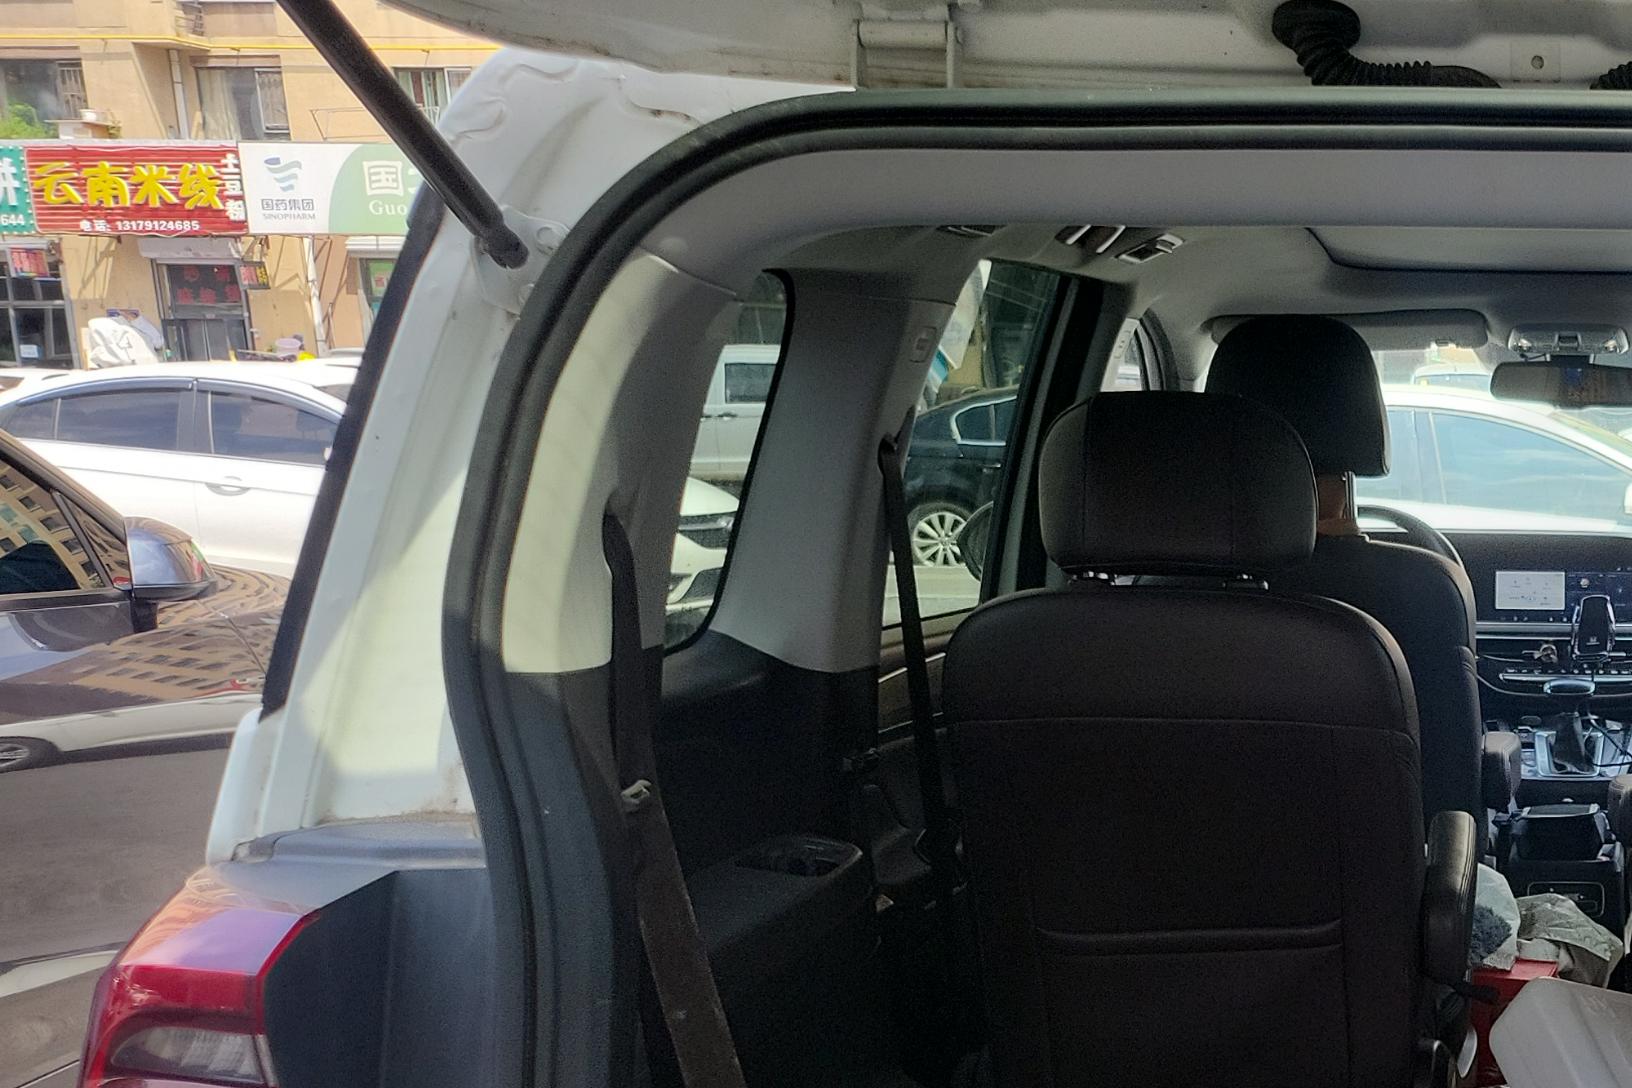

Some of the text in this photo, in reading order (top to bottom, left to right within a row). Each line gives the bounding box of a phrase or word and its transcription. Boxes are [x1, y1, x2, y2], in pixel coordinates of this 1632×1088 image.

[34, 162, 224, 209] 云南米线
[363, 161, 417, 197] 国
[261, 199, 314, 211] 国药集团
[368, 200, 407, 216] Guo
[116, 220, 200, 231] 13179124685
